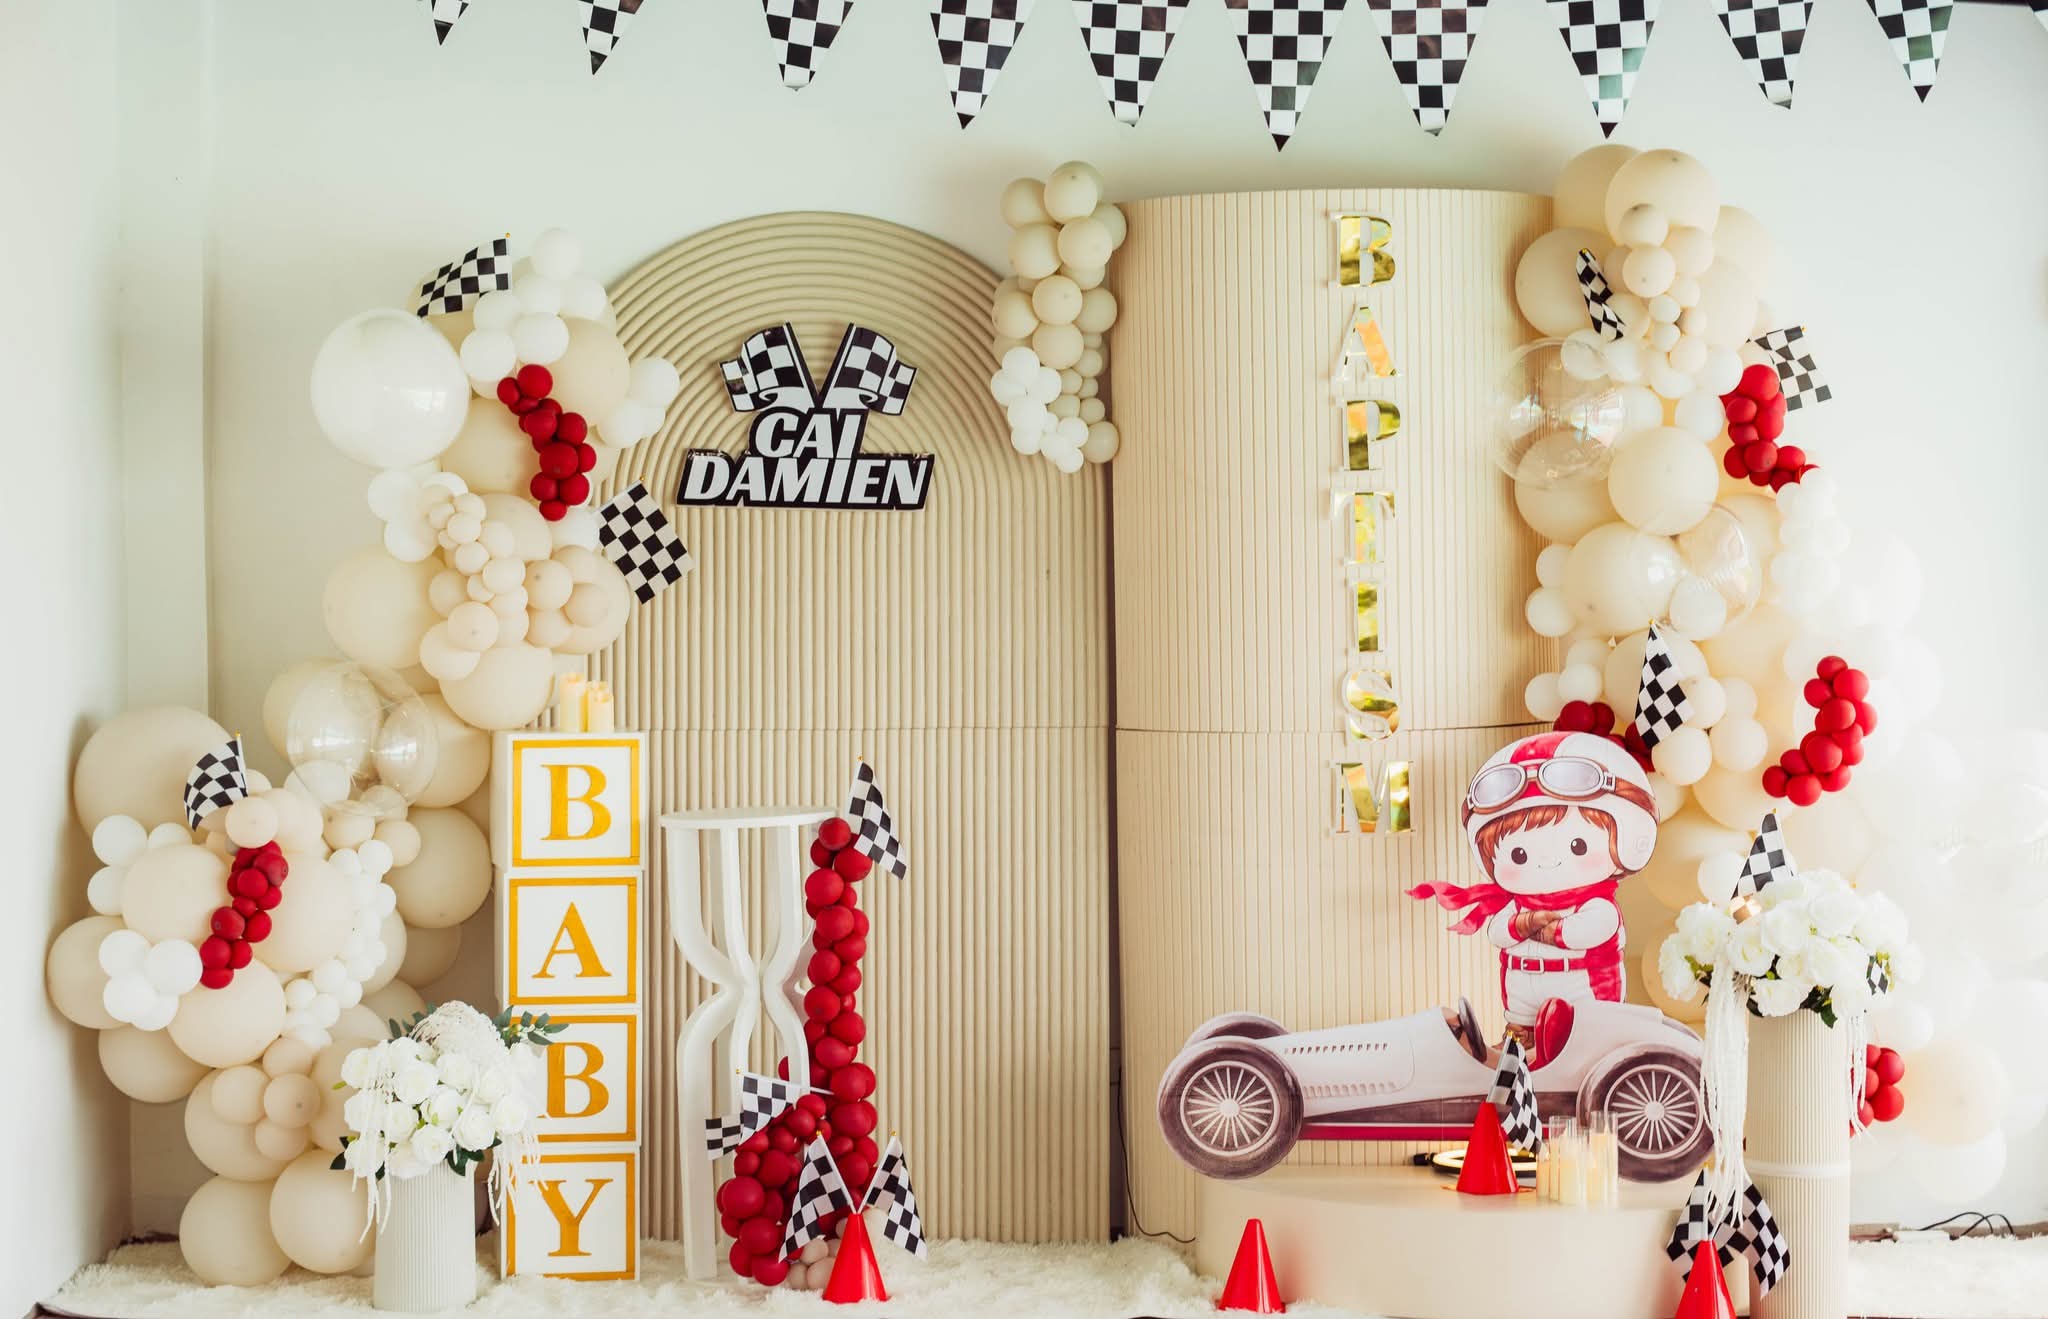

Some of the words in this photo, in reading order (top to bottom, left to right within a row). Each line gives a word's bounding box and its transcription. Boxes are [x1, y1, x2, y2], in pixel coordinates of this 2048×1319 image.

[683, 455, 928, 505] DAMIEN
[755, 411, 862, 459] CAI
[1333, 215, 1416, 833] BAPTISM
[532, 764, 612, 1257] BABY
